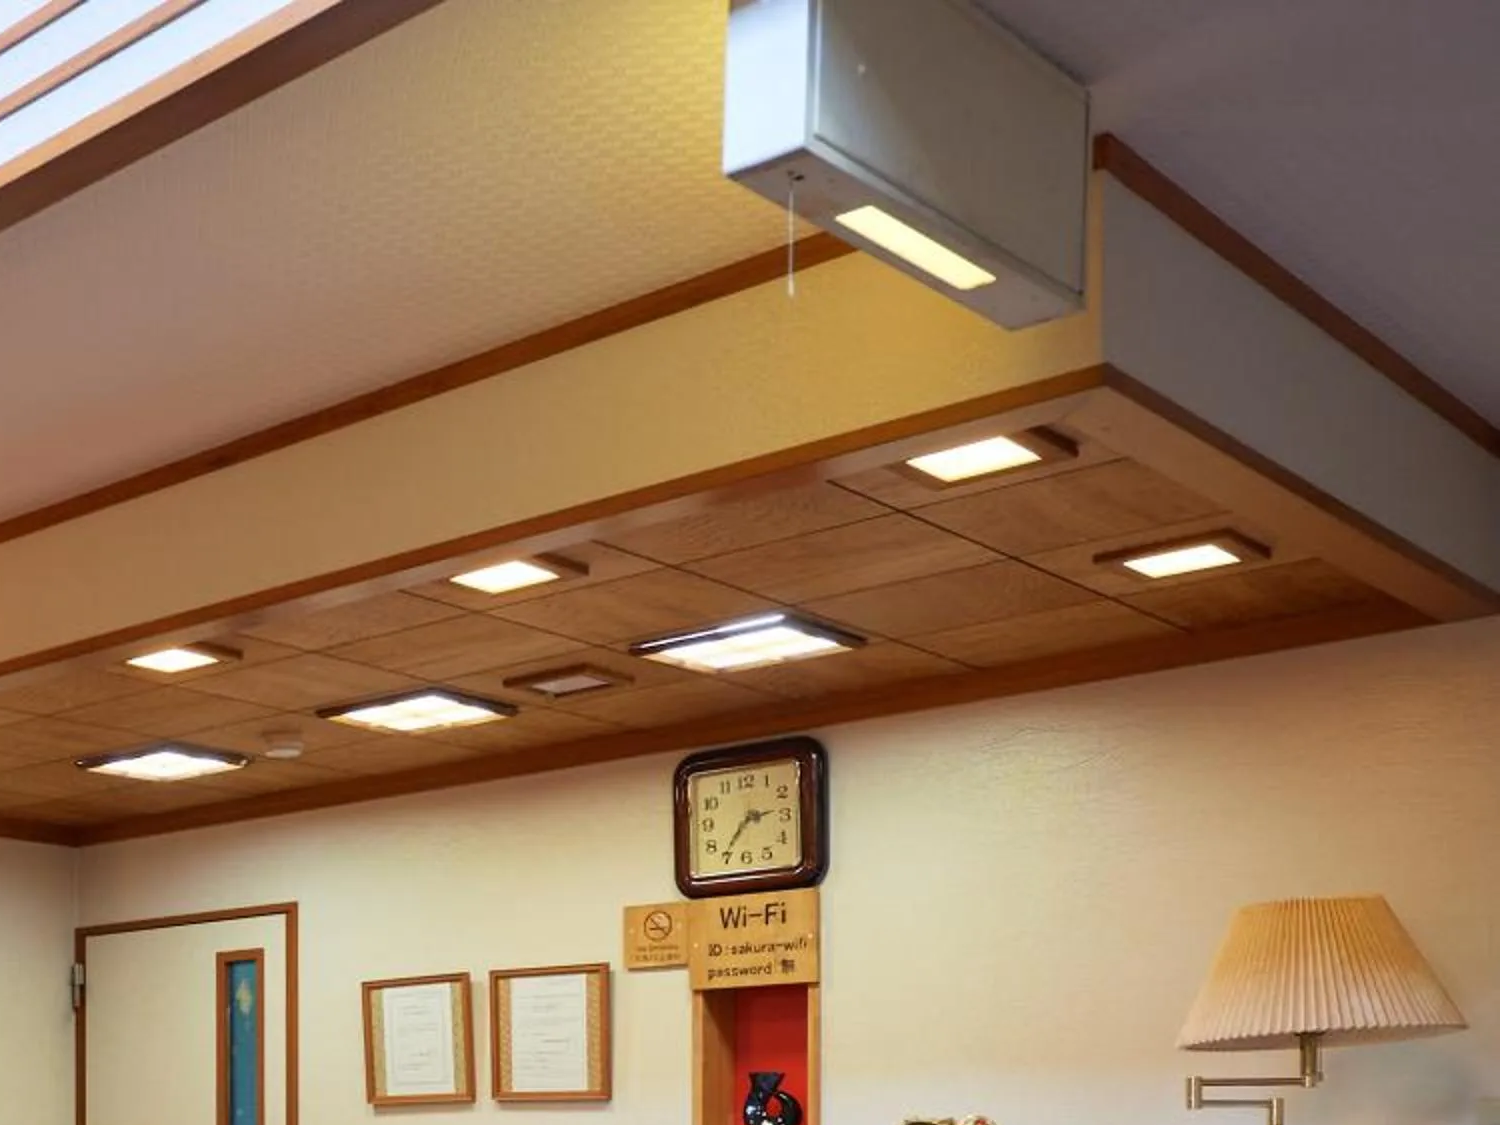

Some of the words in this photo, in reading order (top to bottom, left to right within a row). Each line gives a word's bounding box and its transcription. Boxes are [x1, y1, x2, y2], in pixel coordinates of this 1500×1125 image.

[720, 780, 731, 794] 11
[737, 774, 755, 789] 12
[776, 784, 788, 799] 2
[704, 797, 719, 811] 10
[779, 807, 791, 822] 3
[702, 818, 714, 832] 9
[776, 830, 787, 844] 4
[706, 840, 717, 854] 8
[762, 847, 773, 860] 5
[722, 851, 733, 865] 7
[741, 851, 753, 864] 6
[719, 902, 787, 929] Wi-Fi
